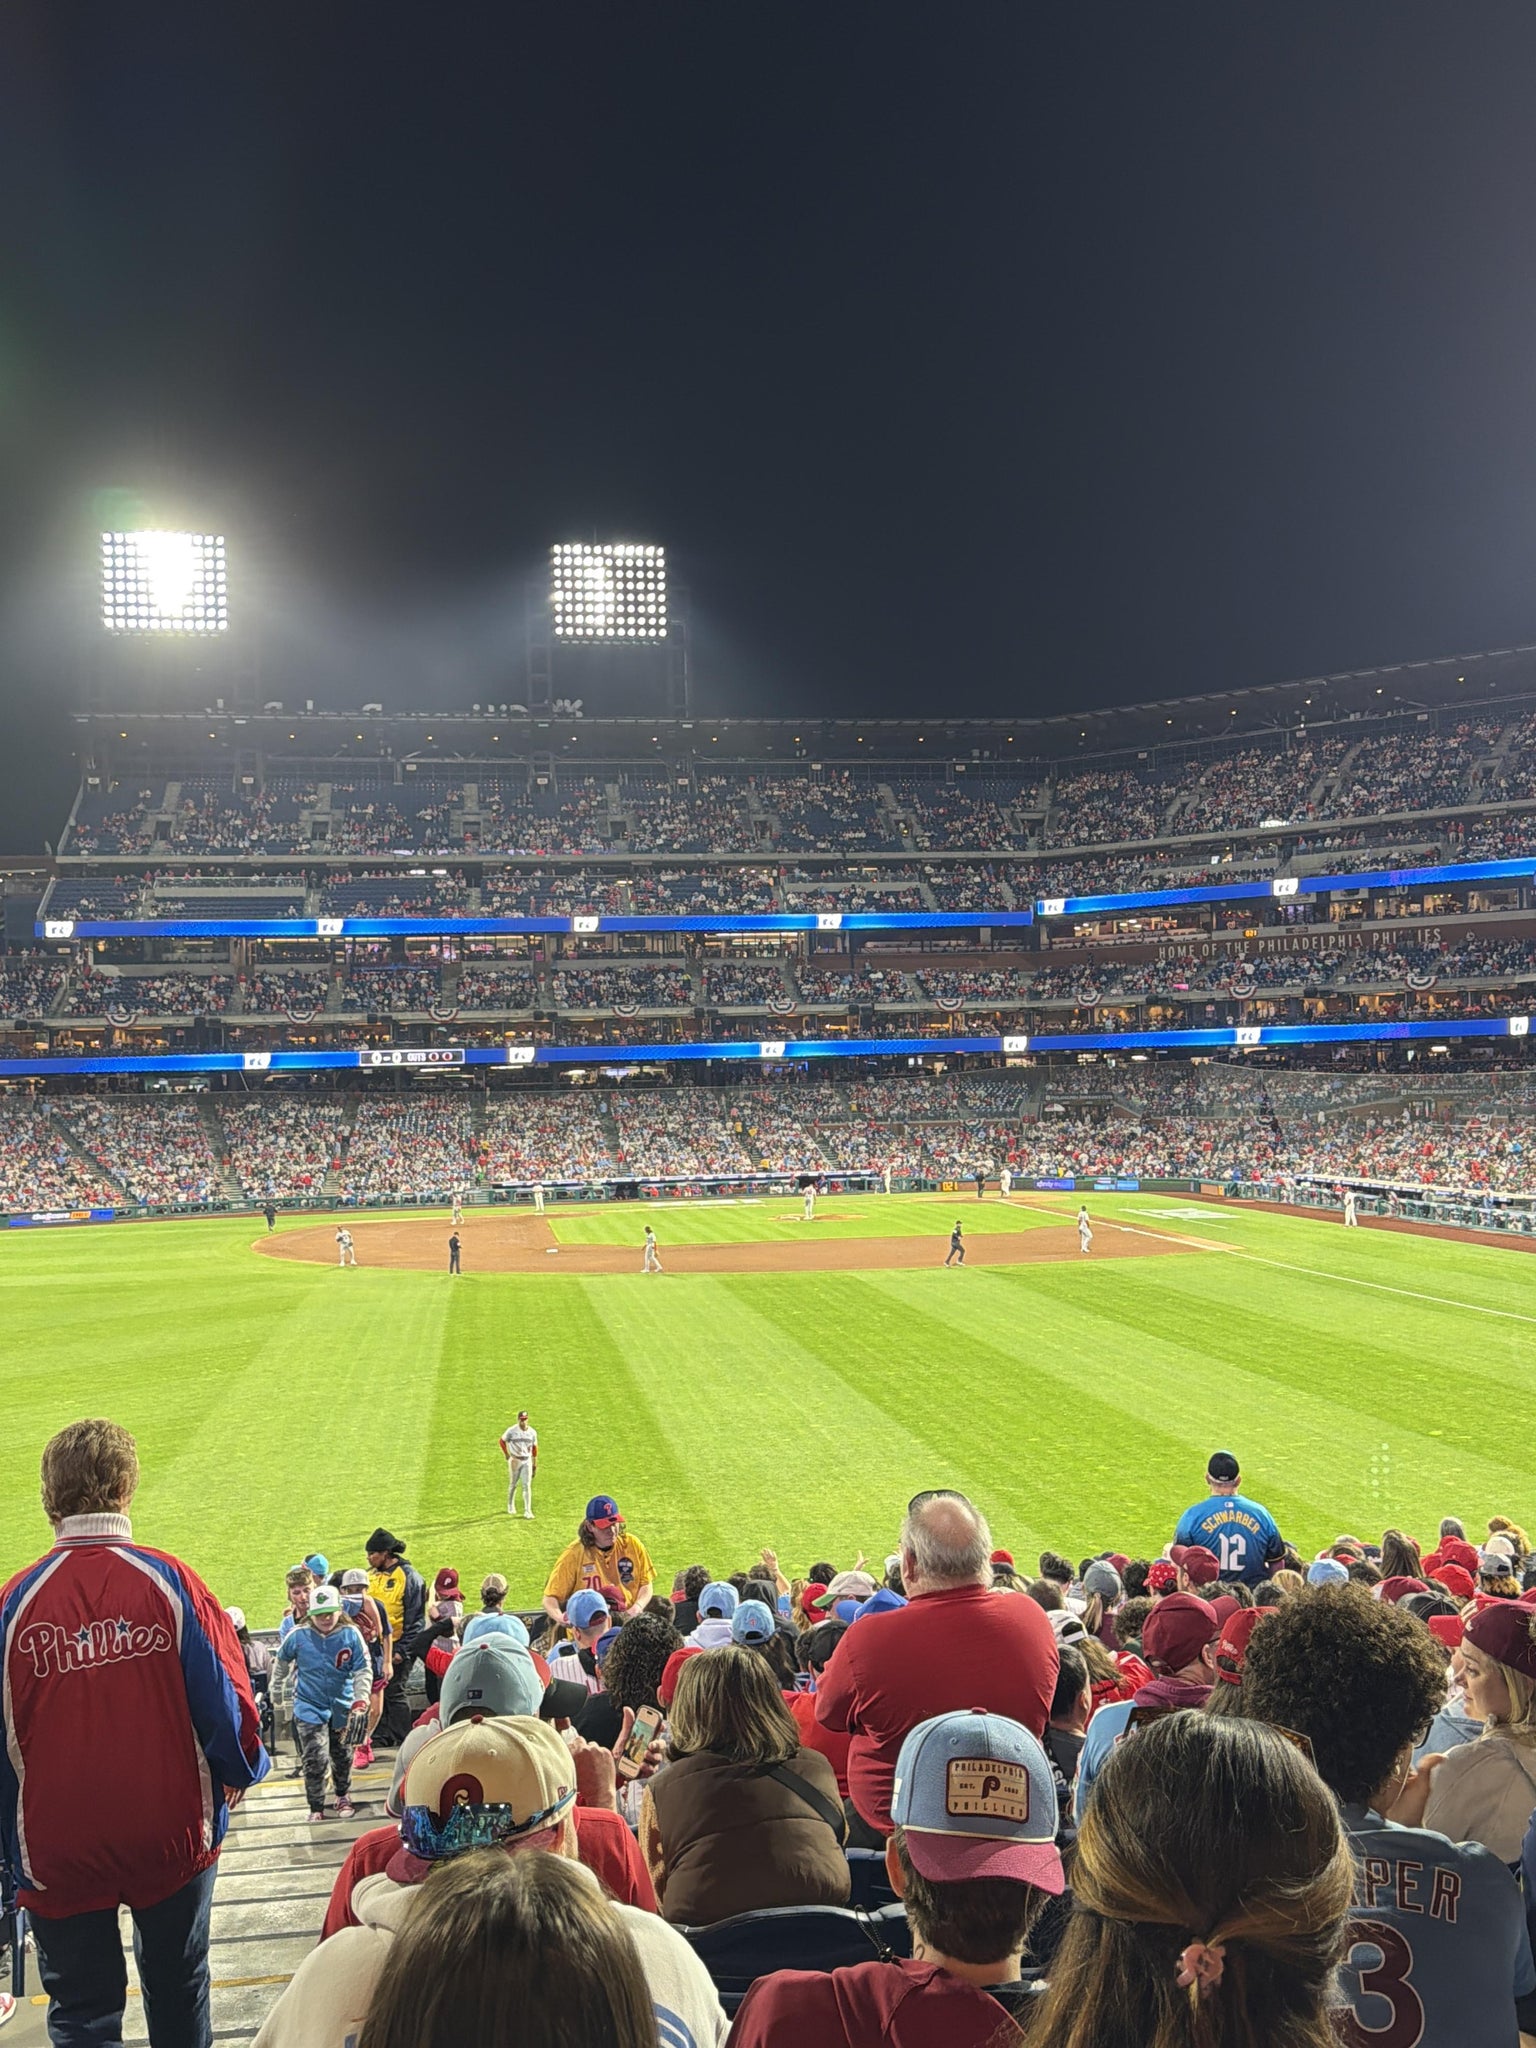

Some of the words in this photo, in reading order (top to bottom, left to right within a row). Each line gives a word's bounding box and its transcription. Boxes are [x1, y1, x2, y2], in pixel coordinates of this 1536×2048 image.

[1158, 943, 1195, 960] HOME
[1202, 942, 1217, 957] OF
[1225, 939, 1250, 955] THE
[1373, 927, 1441, 945] PHIIES
[407, 1052, 427, 1062] OUTS
[1201, 1509, 1261, 1535] SCHWARBER
[1218, 1532, 1247, 1571] 12
[582, 1575, 602, 1591] 70
[18, 1615, 172, 1678] Phillies
[335, 1648, 352, 1669] P
[954, 1763, 1023, 1779] PHILADELPHIA
[953, 1801, 1023, 1817] PHILLIES
[1326, 1918, 1426, 2048] 3
